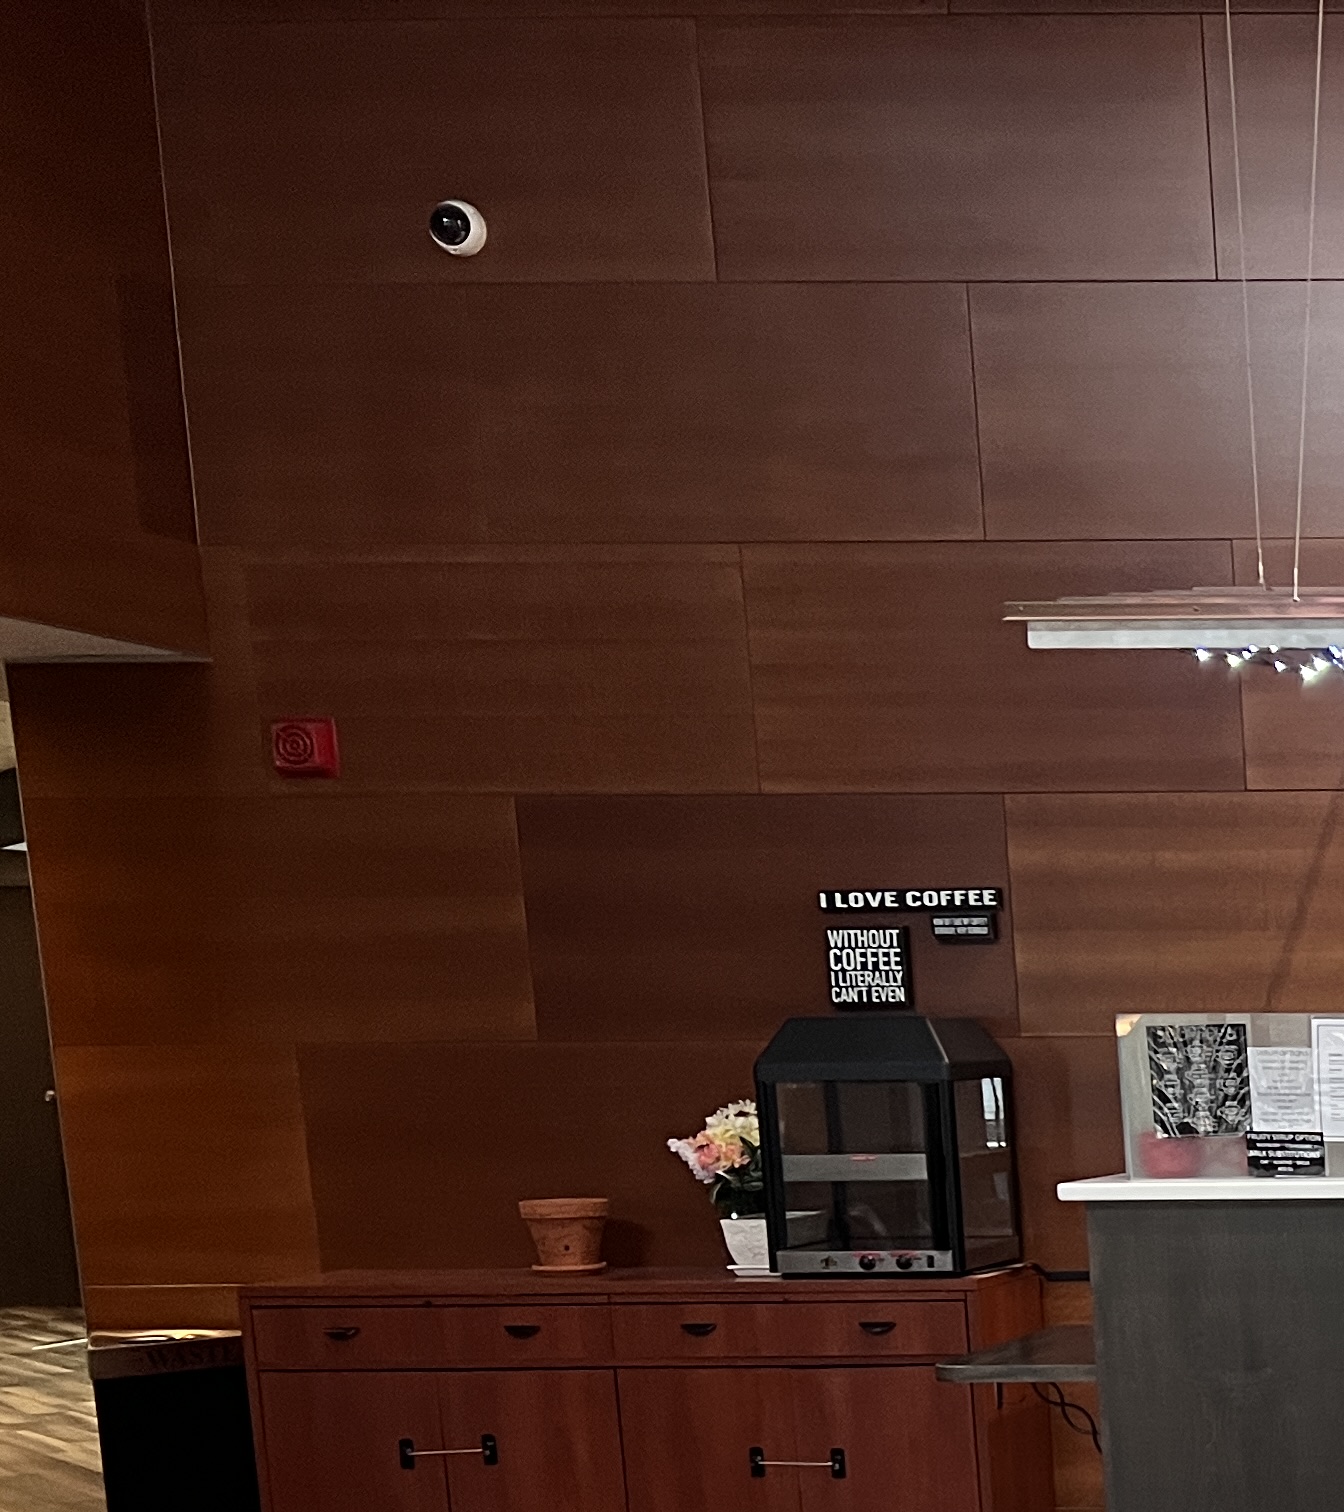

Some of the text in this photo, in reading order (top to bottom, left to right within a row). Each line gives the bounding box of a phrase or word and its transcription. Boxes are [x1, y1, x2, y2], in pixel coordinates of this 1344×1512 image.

[819, 889, 998, 908] I LOVE COFFEE
[827, 929, 900, 948] WITHOUT
[829, 949, 902, 970] COFFEE
[831, 971, 904, 987] I LITERALLY
[871, 987, 906, 1002] EVEN
